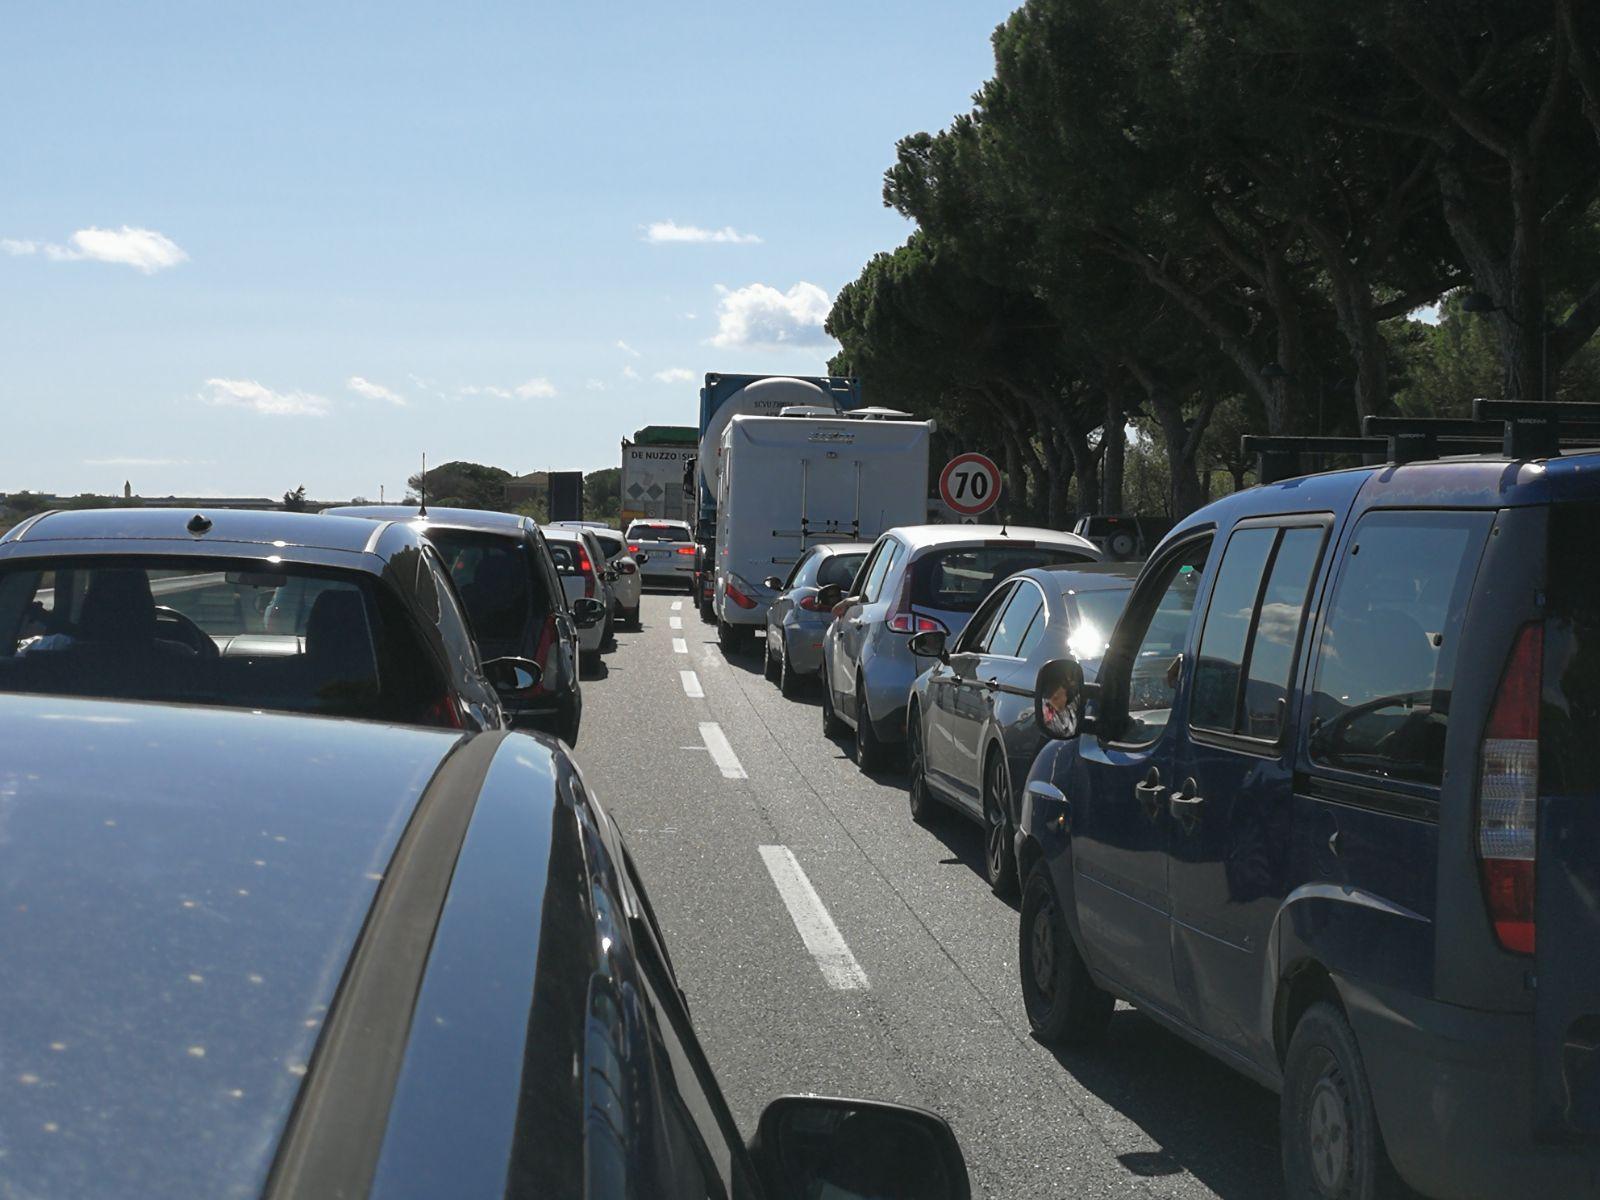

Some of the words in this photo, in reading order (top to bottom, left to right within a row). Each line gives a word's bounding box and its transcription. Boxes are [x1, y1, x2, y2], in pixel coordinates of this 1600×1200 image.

[631, 451, 643, 459] DE
[646, 452, 677, 460] NUZZO
[955, 471, 988, 500] 70
